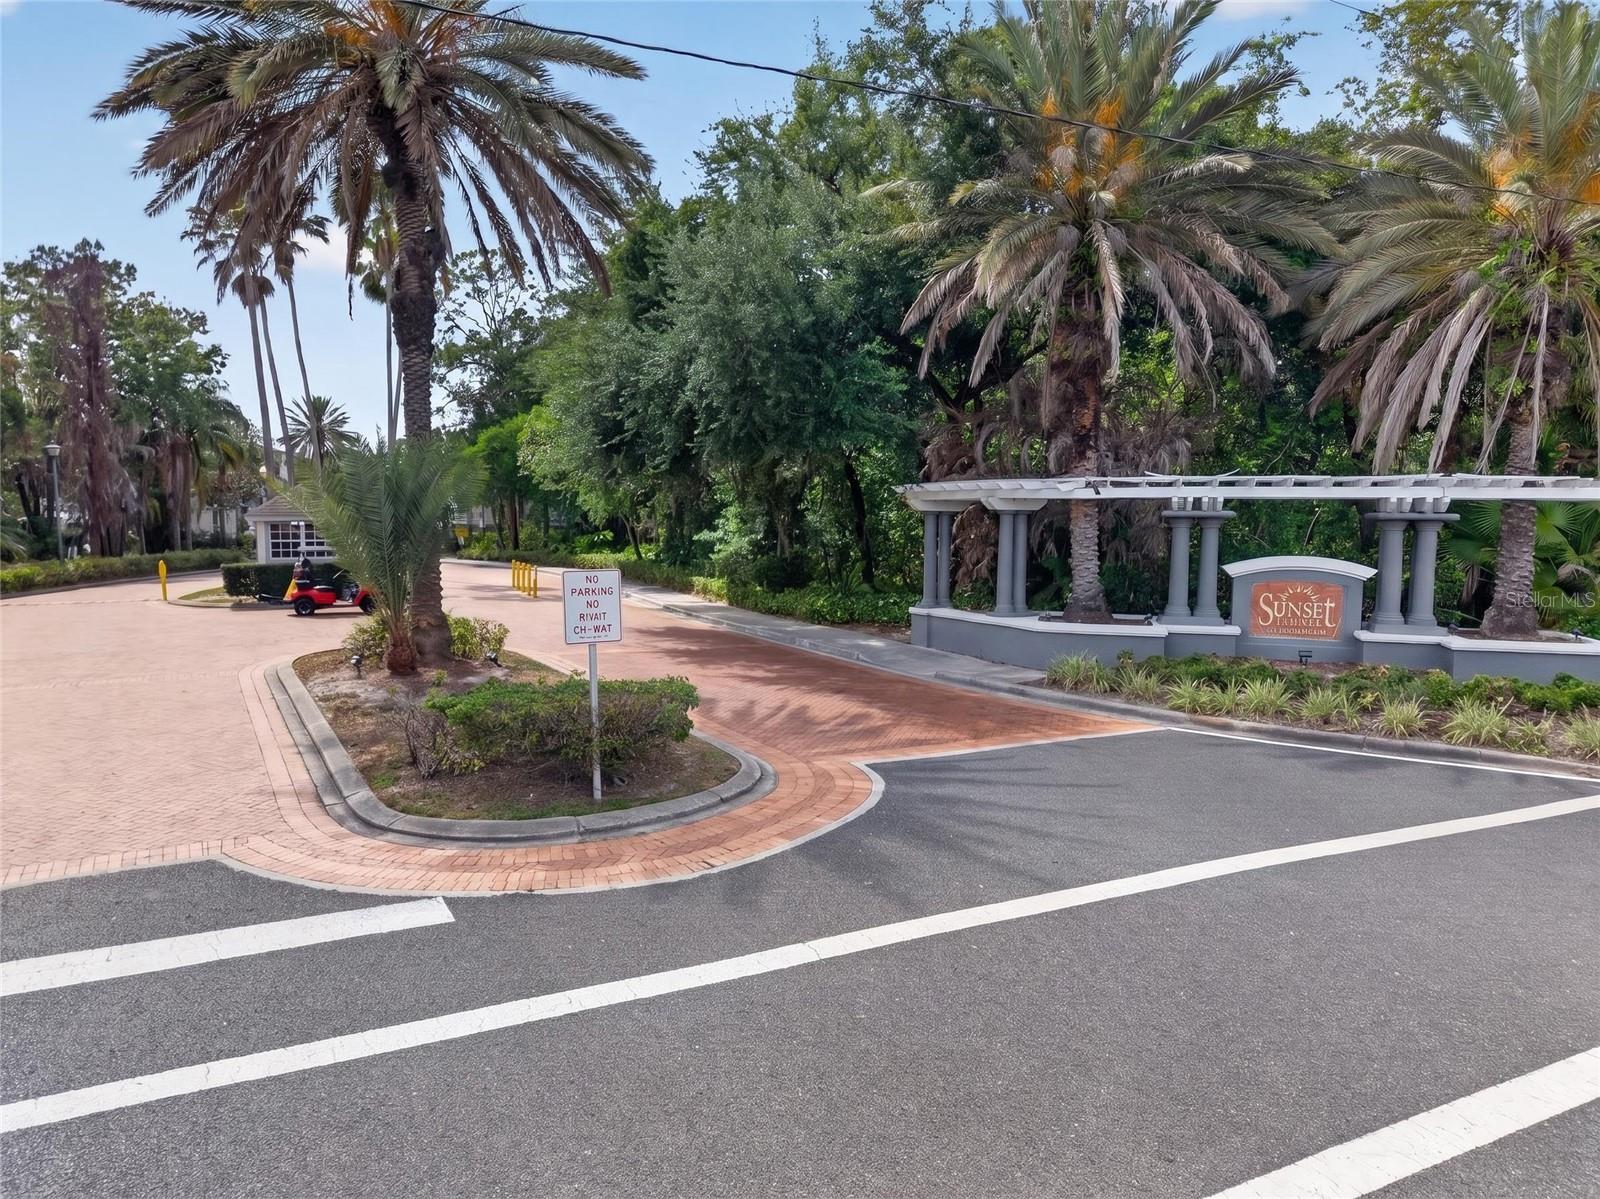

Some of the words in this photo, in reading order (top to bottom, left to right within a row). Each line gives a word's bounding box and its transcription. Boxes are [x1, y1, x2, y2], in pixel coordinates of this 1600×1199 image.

[585, 575, 599, 583] NO
[571, 587, 614, 596] PARKING
[586, 600, 599, 608] NO
